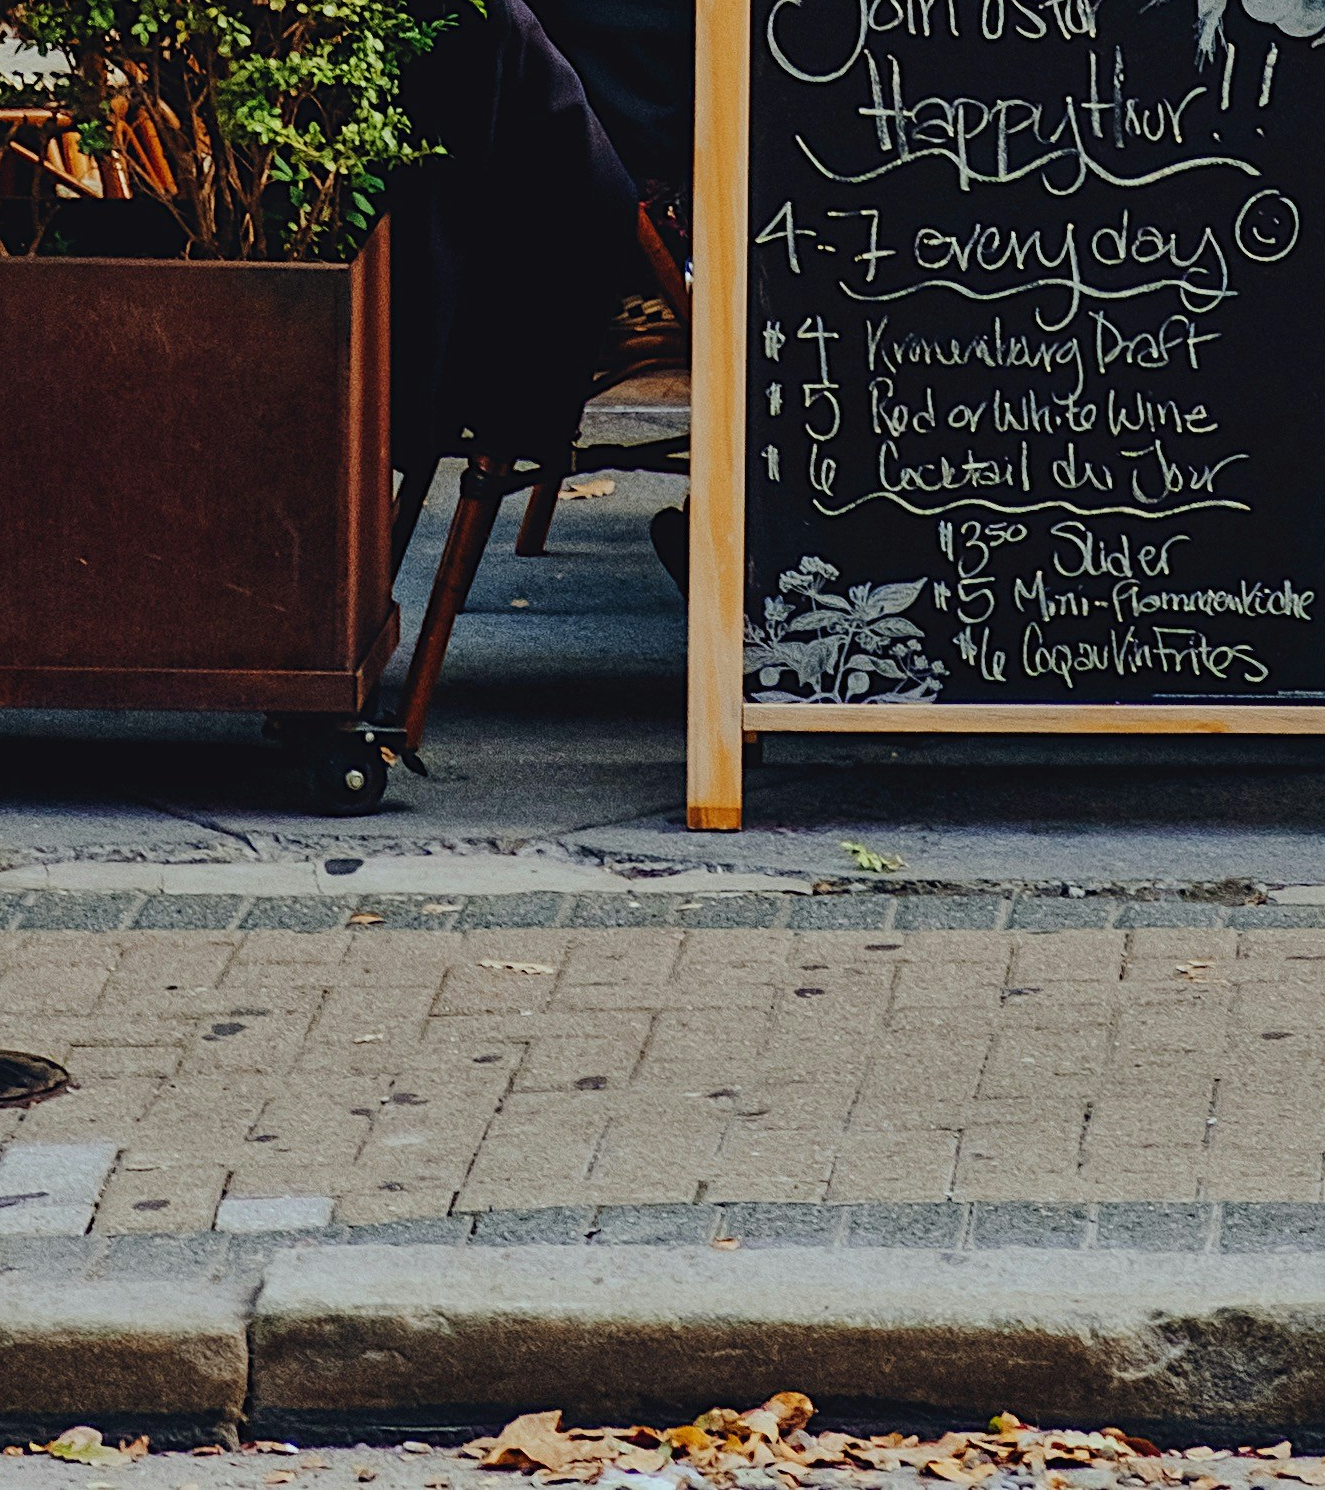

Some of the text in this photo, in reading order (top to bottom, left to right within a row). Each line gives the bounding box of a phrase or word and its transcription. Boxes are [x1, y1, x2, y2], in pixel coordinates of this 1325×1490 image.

[857, 47, 1087, 195] Happy
[913, 222, 1083, 332] every
[1090, 208, 1239, 313] day
[1087, 310, 1223, 375] Draft
[868, 378, 937, 435] Red
[946, 403, 986, 428] or
[991, 386, 1099, 437] White
[1107, 388, 1220, 438] Wine
[877, 440, 1032, 494] Cocktail
[1051, 440, 1115, 491] du
[1118, 439, 1251, 504] Jour
[1049, 519, 1192, 579] Slider
[1021, 621, 1075, 690] Coq
[1074, 641, 1110, 672] au
[1109, 623, 1154, 676] Vin
[1150, 625, 1271, 685] Frites
